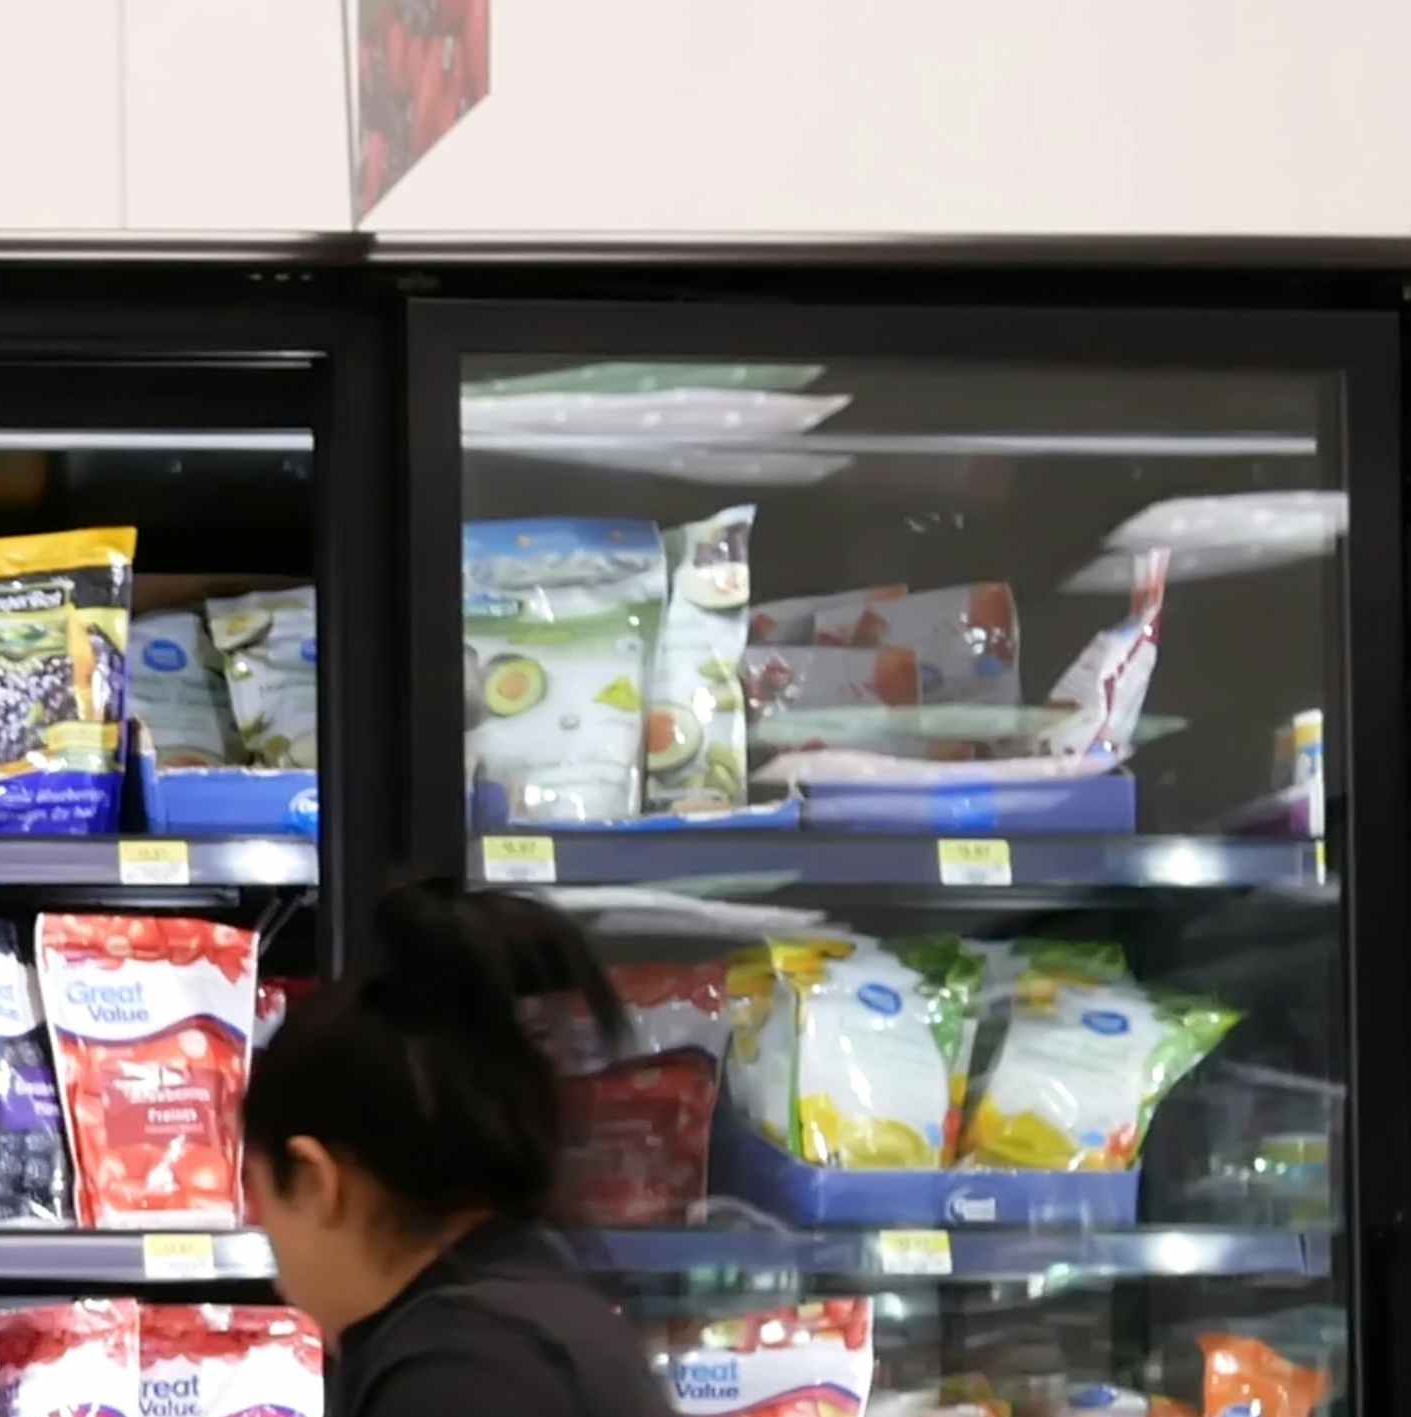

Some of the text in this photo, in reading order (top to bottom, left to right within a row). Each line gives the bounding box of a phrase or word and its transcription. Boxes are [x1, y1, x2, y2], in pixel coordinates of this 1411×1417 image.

[65, 980, 144, 1005] Great
[86, 1004, 150, 1024] Value
[140, 1376, 201, 1400] reat
[676, 1382, 740, 1400] Value
